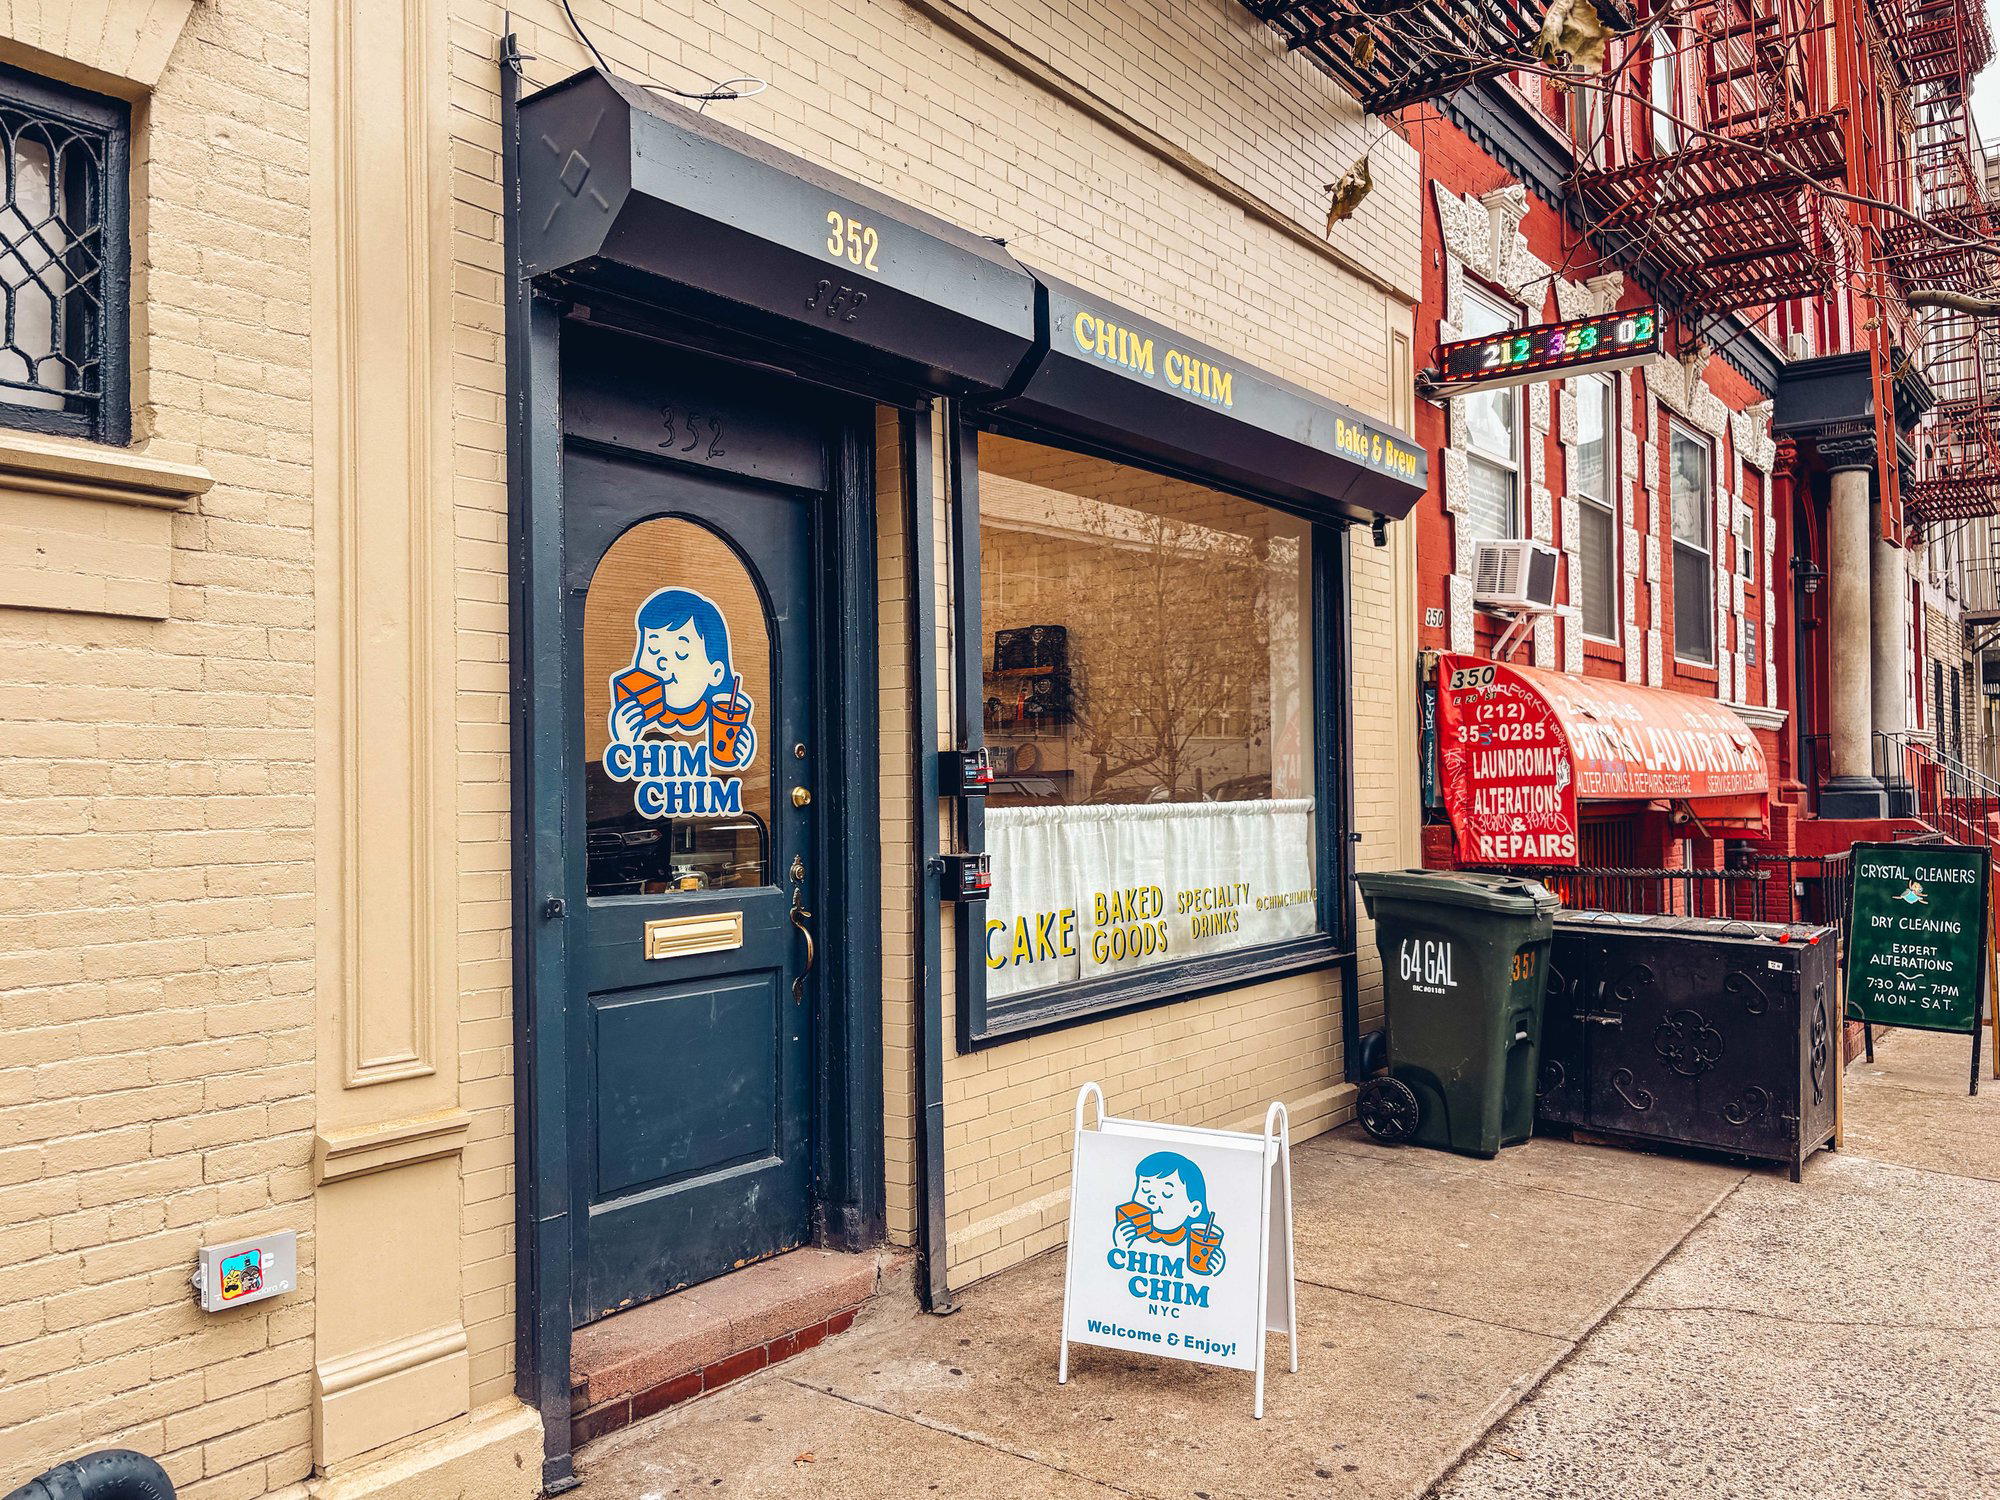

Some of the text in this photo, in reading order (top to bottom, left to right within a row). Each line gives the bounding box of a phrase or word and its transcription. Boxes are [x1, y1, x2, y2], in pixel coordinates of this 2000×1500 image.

[826, 210, 879, 273] 352
[805, 279, 868, 323] 352
[1073, 312, 1234, 409] CHIM CHIM
[658, 406, 726, 459] 352
[1335, 418, 1417, 478] Bake & Brew
[1427, 609, 1444, 626] 350
[1453, 667, 1495, 689] 350
[1466, 695, 1477, 704] 20
[1476, 703, 1525, 722] (212)
[606, 743, 708, 778] CHIM
[1473, 747, 1562, 779] LAUNDROMAT
[1577, 771, 1629, 793] ALTERATIONS
[638, 780, 741, 816] CHIM
[1474, 785, 1562, 814] ALTERATIONS
[1512, 817, 1527, 832] &
[1480, 834, 1576, 858] REPAIRS
[1860, 864, 1976, 884] CRYSTAL CLEANERS
[1095, 885, 1164, 926] BAKED
[1177, 882, 1250, 914] SPECIALTY
[985, 908, 1077, 970] CAKE
[1191, 909, 1239, 940] DRINKS
[1871, 916, 1961, 934] DRY CLEANING
[1092, 922, 1168, 965] GOODS
[1892, 943, 1938, 956] EXPERT
[1400, 938, 1458, 987] 64 GAL
[1870, 954, 1954, 972] ALTERATIONS
[1866, 977, 1893, 989] 7:30
[1898, 981, 1916, 991] AM
[1931, 984, 1959, 996] 7:PM
[1874, 993, 1907, 1006] MON
[1920, 998, 1954, 1011] SAT.
[1107, 1248, 1185, 1279] CHIM
[1128, 1276, 1210, 1308] CHIM
[1149, 1304, 1180, 1319] NYC
[1087, 1319, 1237, 1357] Welcome & Enjoy!
